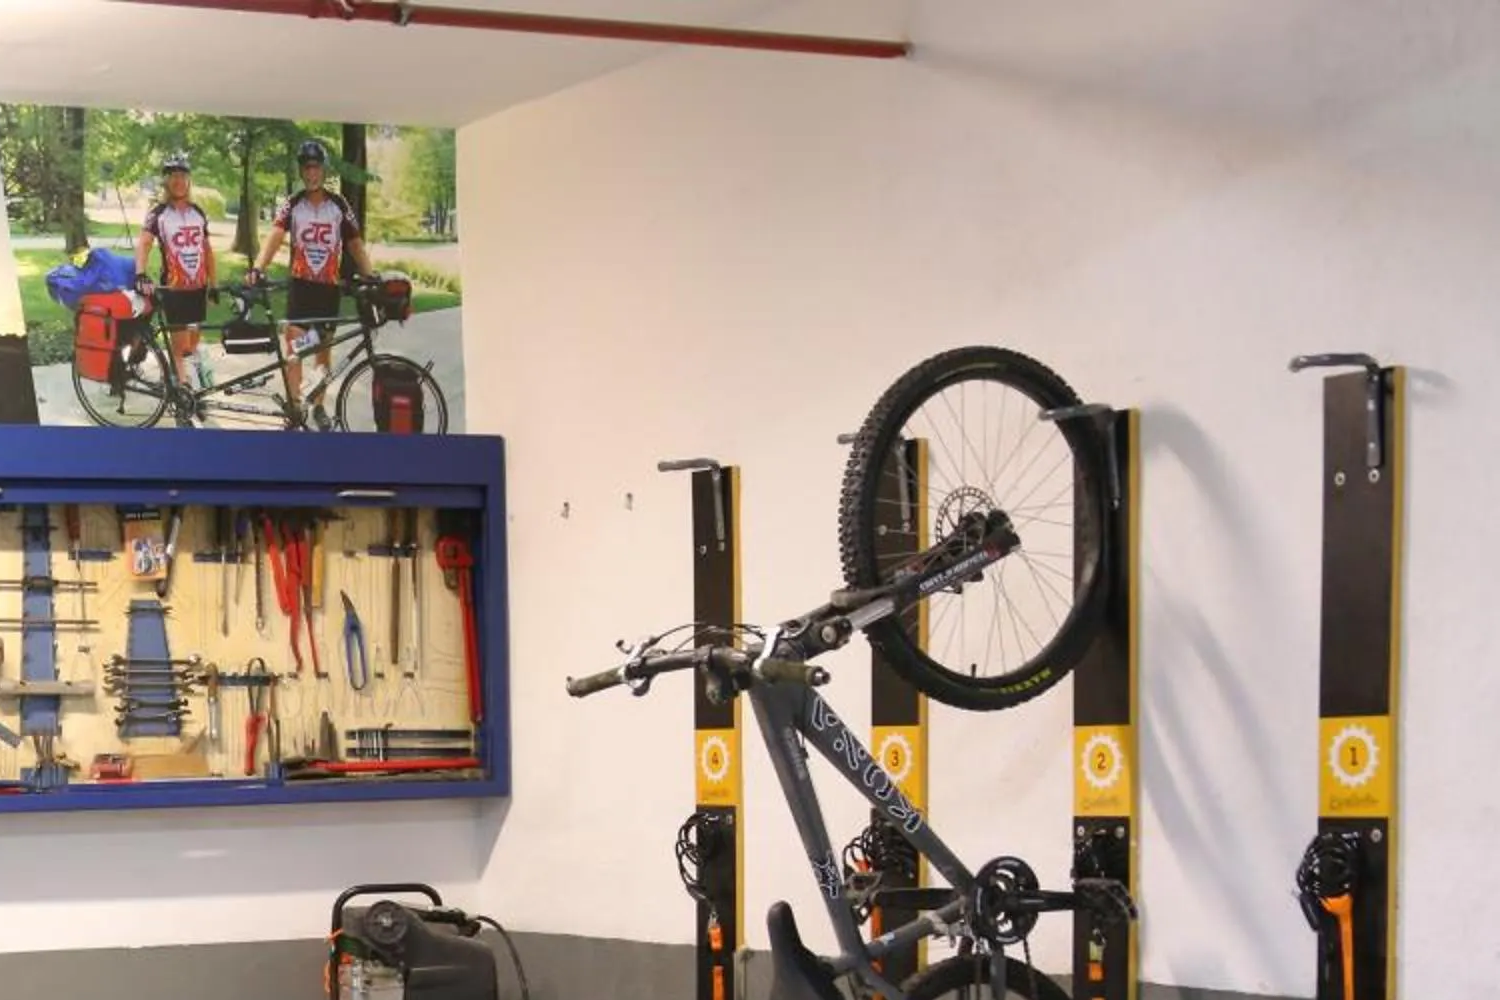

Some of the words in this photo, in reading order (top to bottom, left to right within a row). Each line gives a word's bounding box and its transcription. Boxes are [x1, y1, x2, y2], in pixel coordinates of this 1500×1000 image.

[301, 222, 333, 244] CTC
[711, 751, 720, 766] 4
[891, 749, 899, 767] 3
[1096, 751, 1106, 771] 2
[1349, 746, 1359, 767] 1
